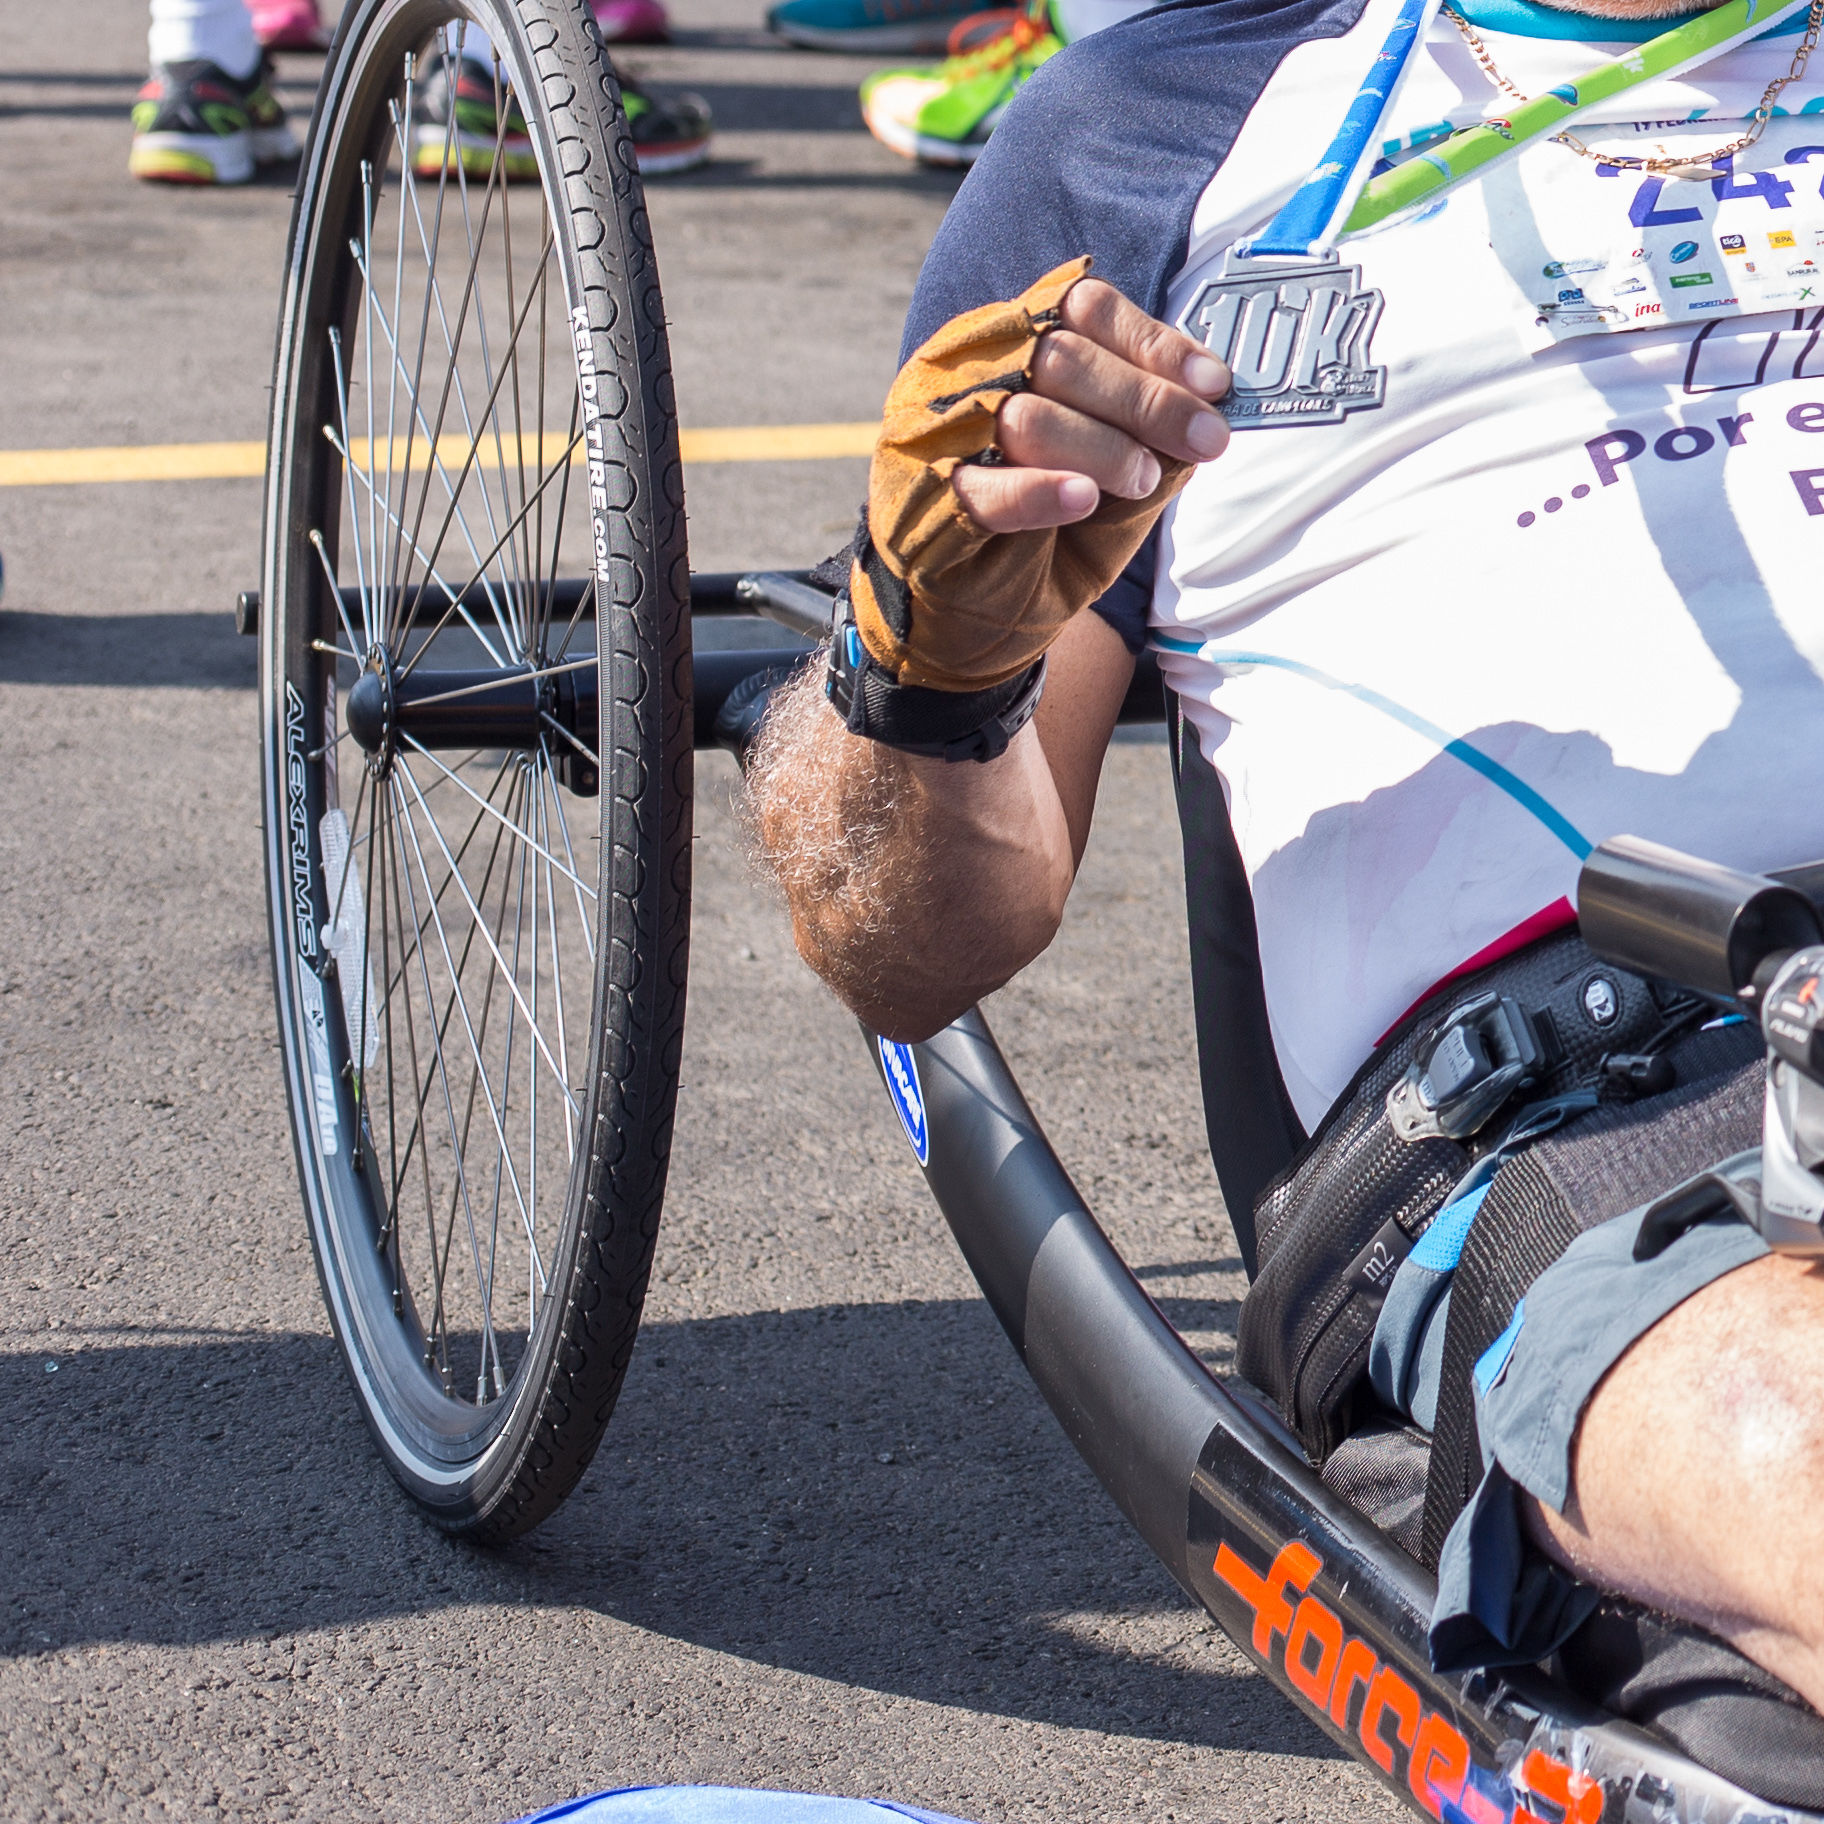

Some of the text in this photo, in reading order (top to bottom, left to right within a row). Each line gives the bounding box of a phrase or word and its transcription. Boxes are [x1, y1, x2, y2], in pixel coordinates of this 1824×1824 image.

[571, 303, 611, 582] KENDATIRE.COM
[286, 680, 318, 959] ALEXRIMS
[1361, 1240, 1395, 1283] m2
